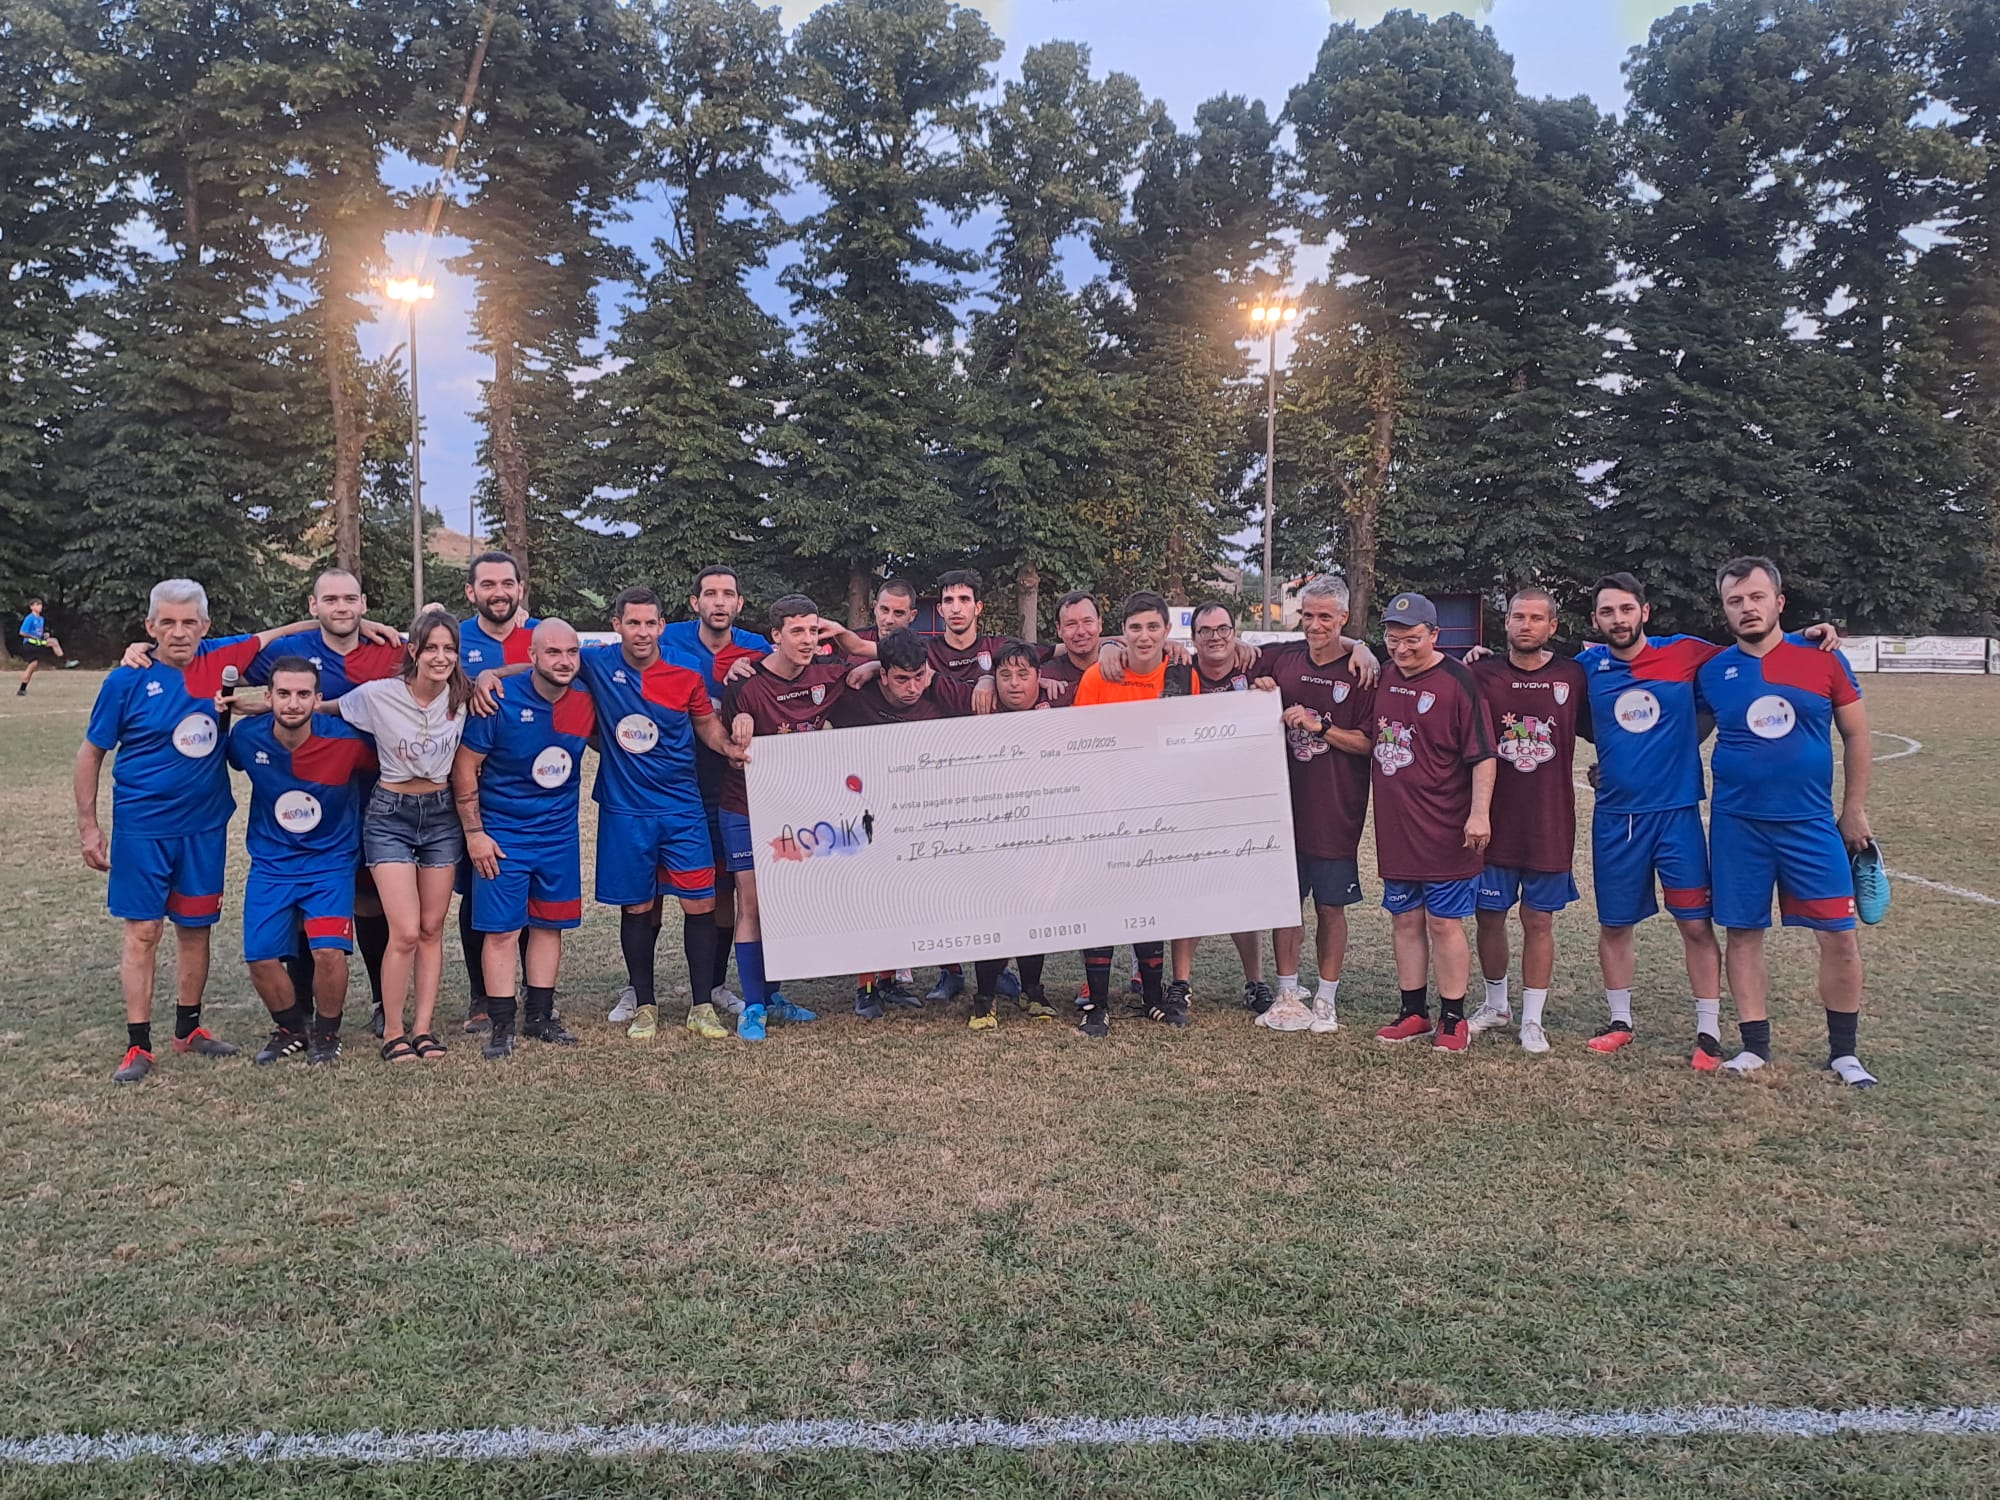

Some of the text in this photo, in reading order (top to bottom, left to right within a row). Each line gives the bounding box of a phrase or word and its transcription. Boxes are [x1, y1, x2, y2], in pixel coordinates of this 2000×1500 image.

[1300, 674, 1333, 686] GIVOVA
[776, 690, 809, 702] GIVOVA
[888, 764, 916, 773] Luogo
[1040, 749, 1061, 759] Data
[1066, 736, 1118, 752] 01/07/2025
[1166, 736, 1187, 747] Euro
[1194, 724, 1237, 741] 500.00
[1515, 746, 1551, 757] PONTE
[892, 784, 1081, 810] A vista pagate per questo assegno bancario
[894, 825, 914, 834] euro
[1107, 861, 1131, 870] firma
[911, 916, 1156, 952] 1234567890 01010101 1234
